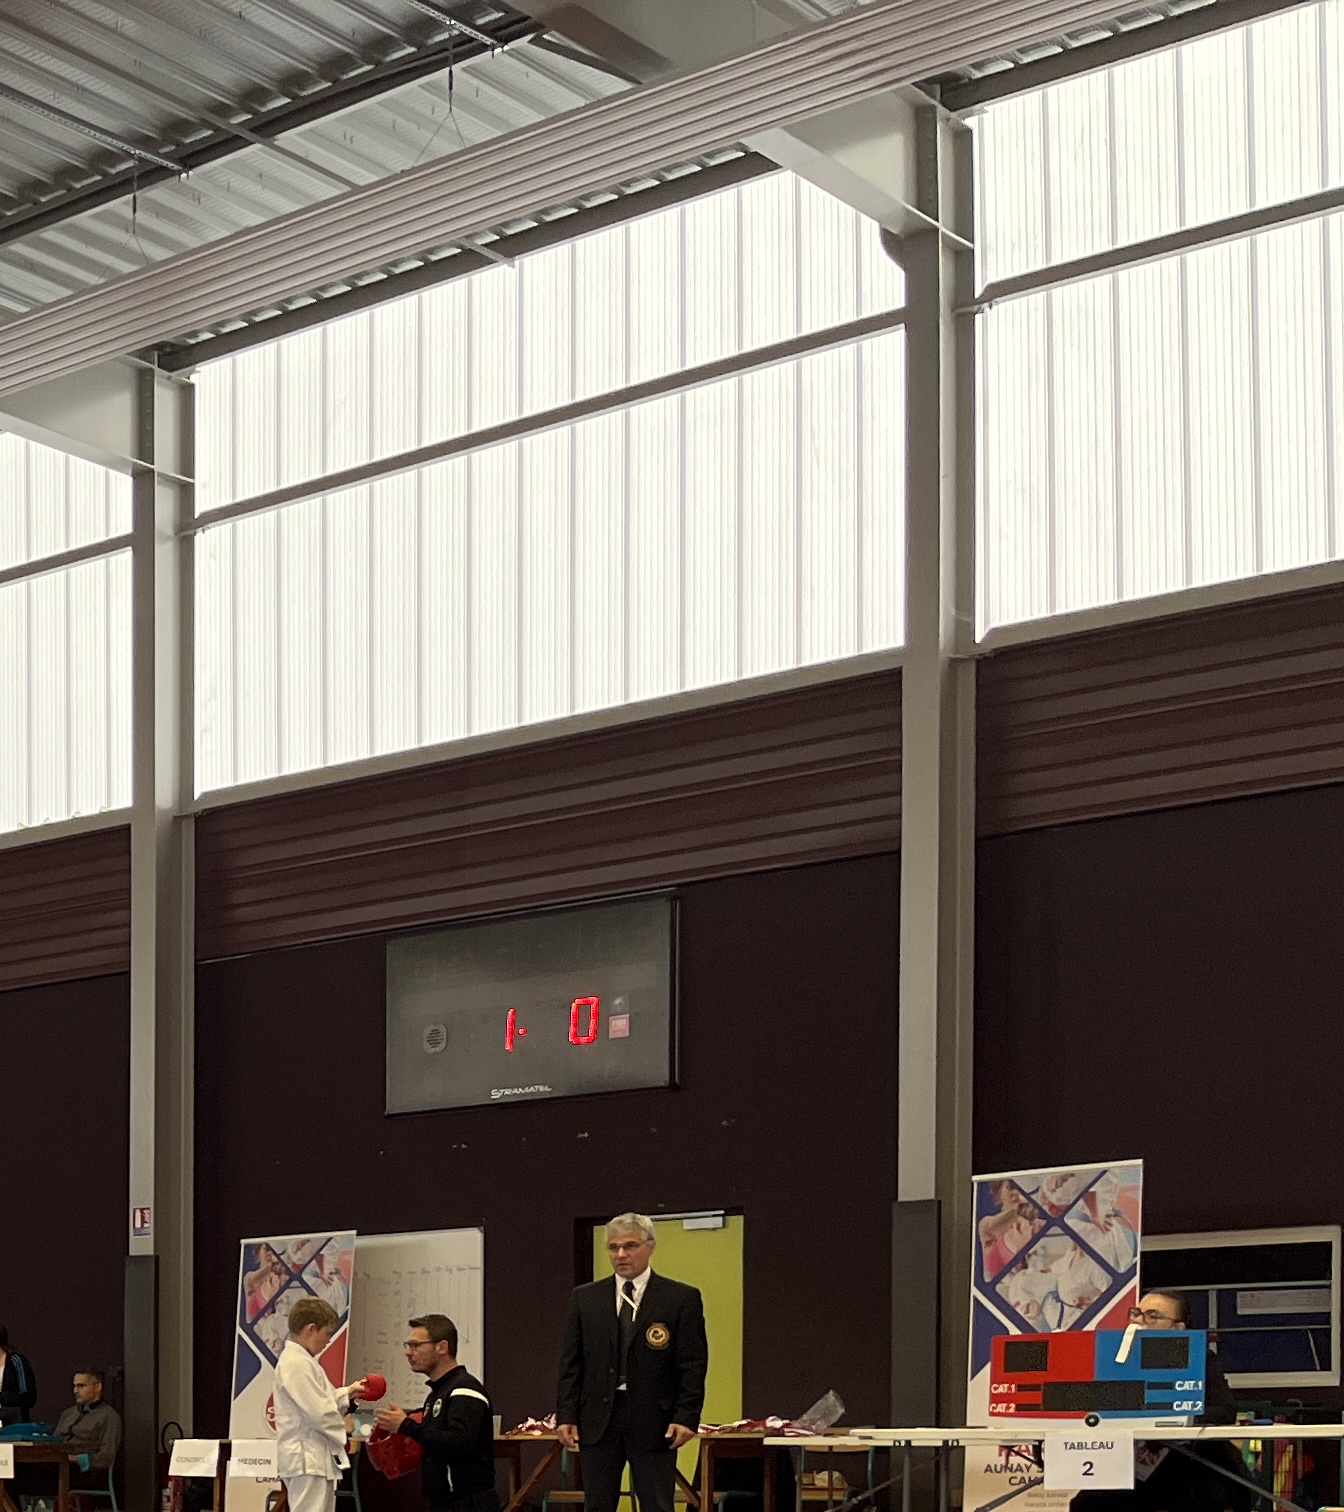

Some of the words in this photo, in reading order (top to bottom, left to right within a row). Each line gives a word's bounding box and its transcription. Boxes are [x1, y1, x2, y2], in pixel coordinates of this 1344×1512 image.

[569, 996, 599, 1045] 0
[991, 1383, 1015, 1394] CAT.1
[1063, 1441, 1114, 1450] TABLEAU
[984, 1463, 1033, 1473] AUNAY
[1081, 1461, 1095, 1476] 2
